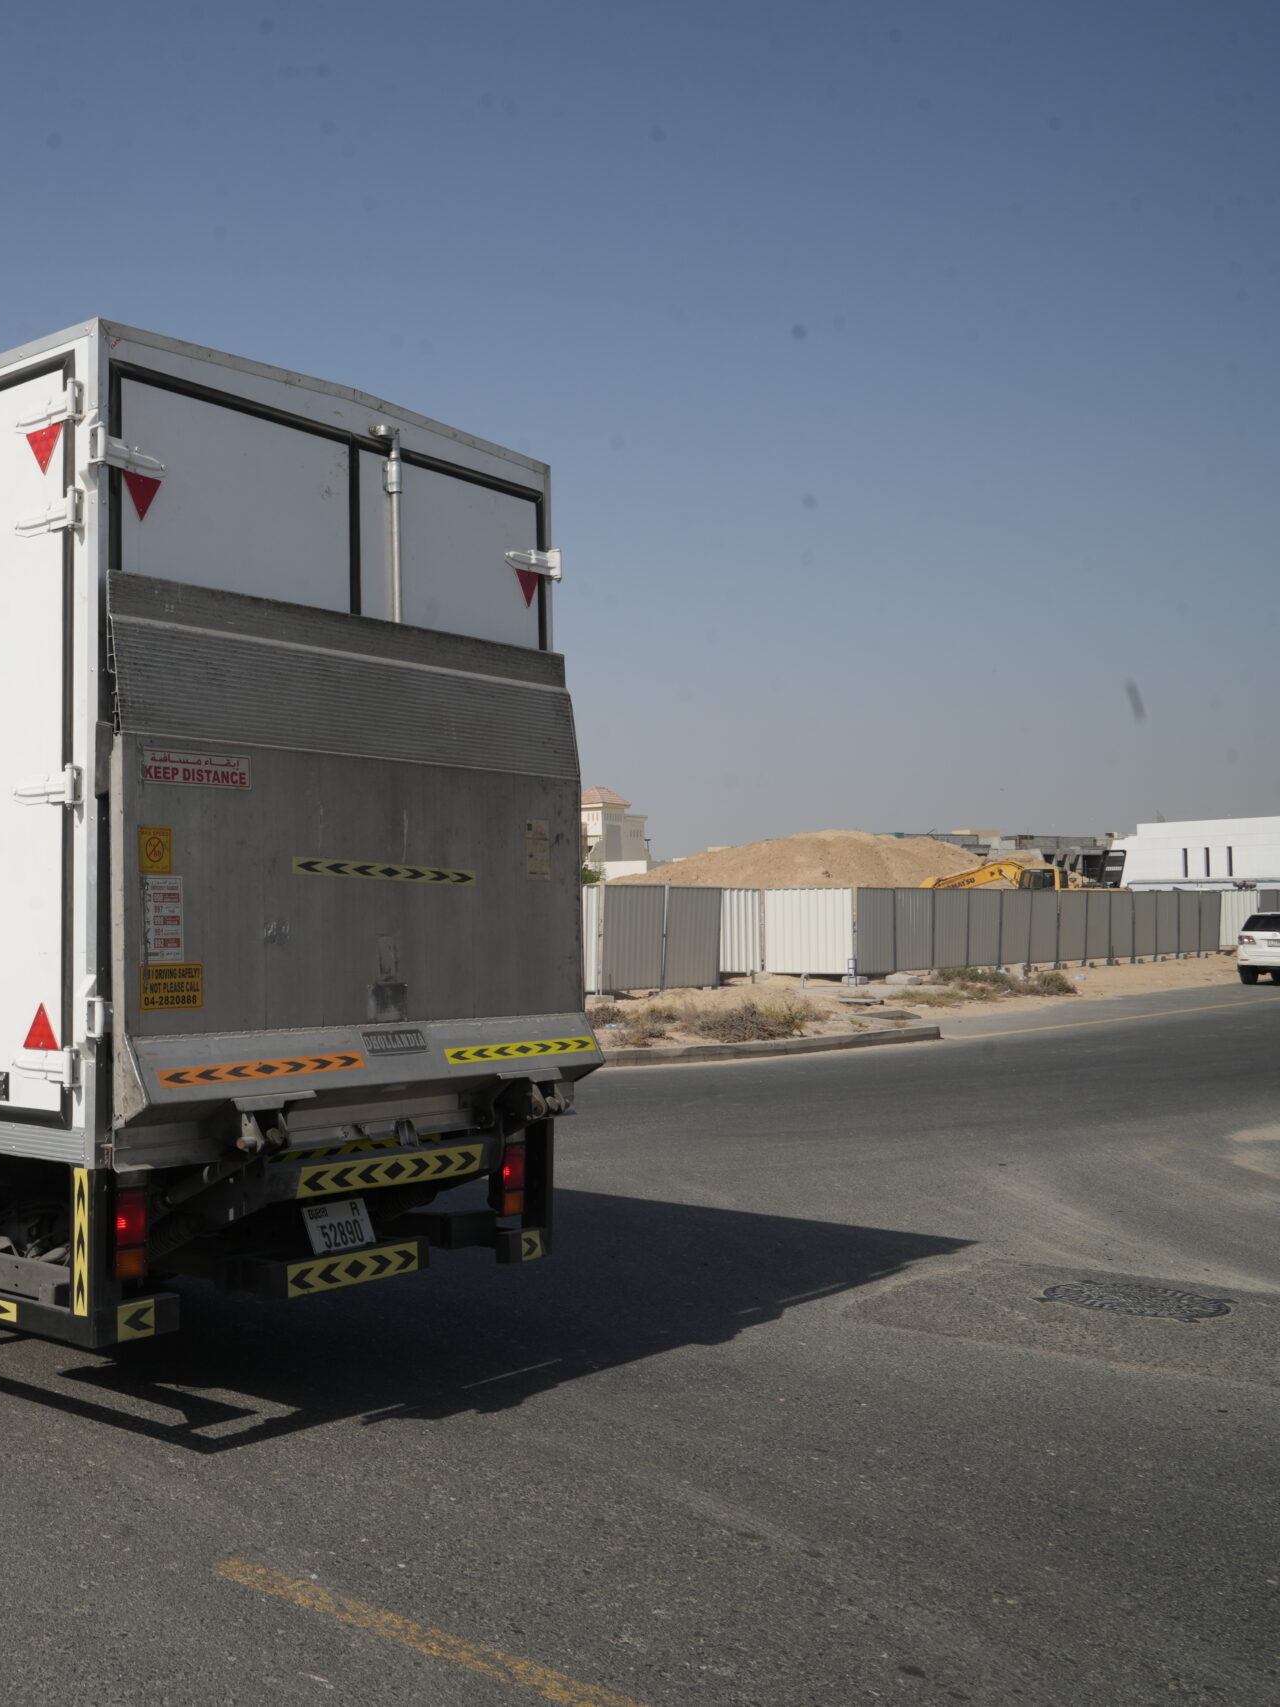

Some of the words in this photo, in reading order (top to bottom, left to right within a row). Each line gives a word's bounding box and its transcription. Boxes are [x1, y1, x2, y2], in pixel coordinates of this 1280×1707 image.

[144, 765, 179, 780] KEEP
[182, 767, 246, 785] DISTANCE
[155, 968, 177, 979] DRIVING
[178, 967, 200, 979] SAFELY?
[149, 982, 161, 994] NOT
[163, 981, 185, 993] PLEASE
[186, 981, 200, 993] CALL
[144, 994, 197, 1007] 04-2820888
[363, 1032, 426, 1050] DHOLLANDIA
[349, 1201, 360, 1217] R
[320, 1219, 365, 1249] 52890
